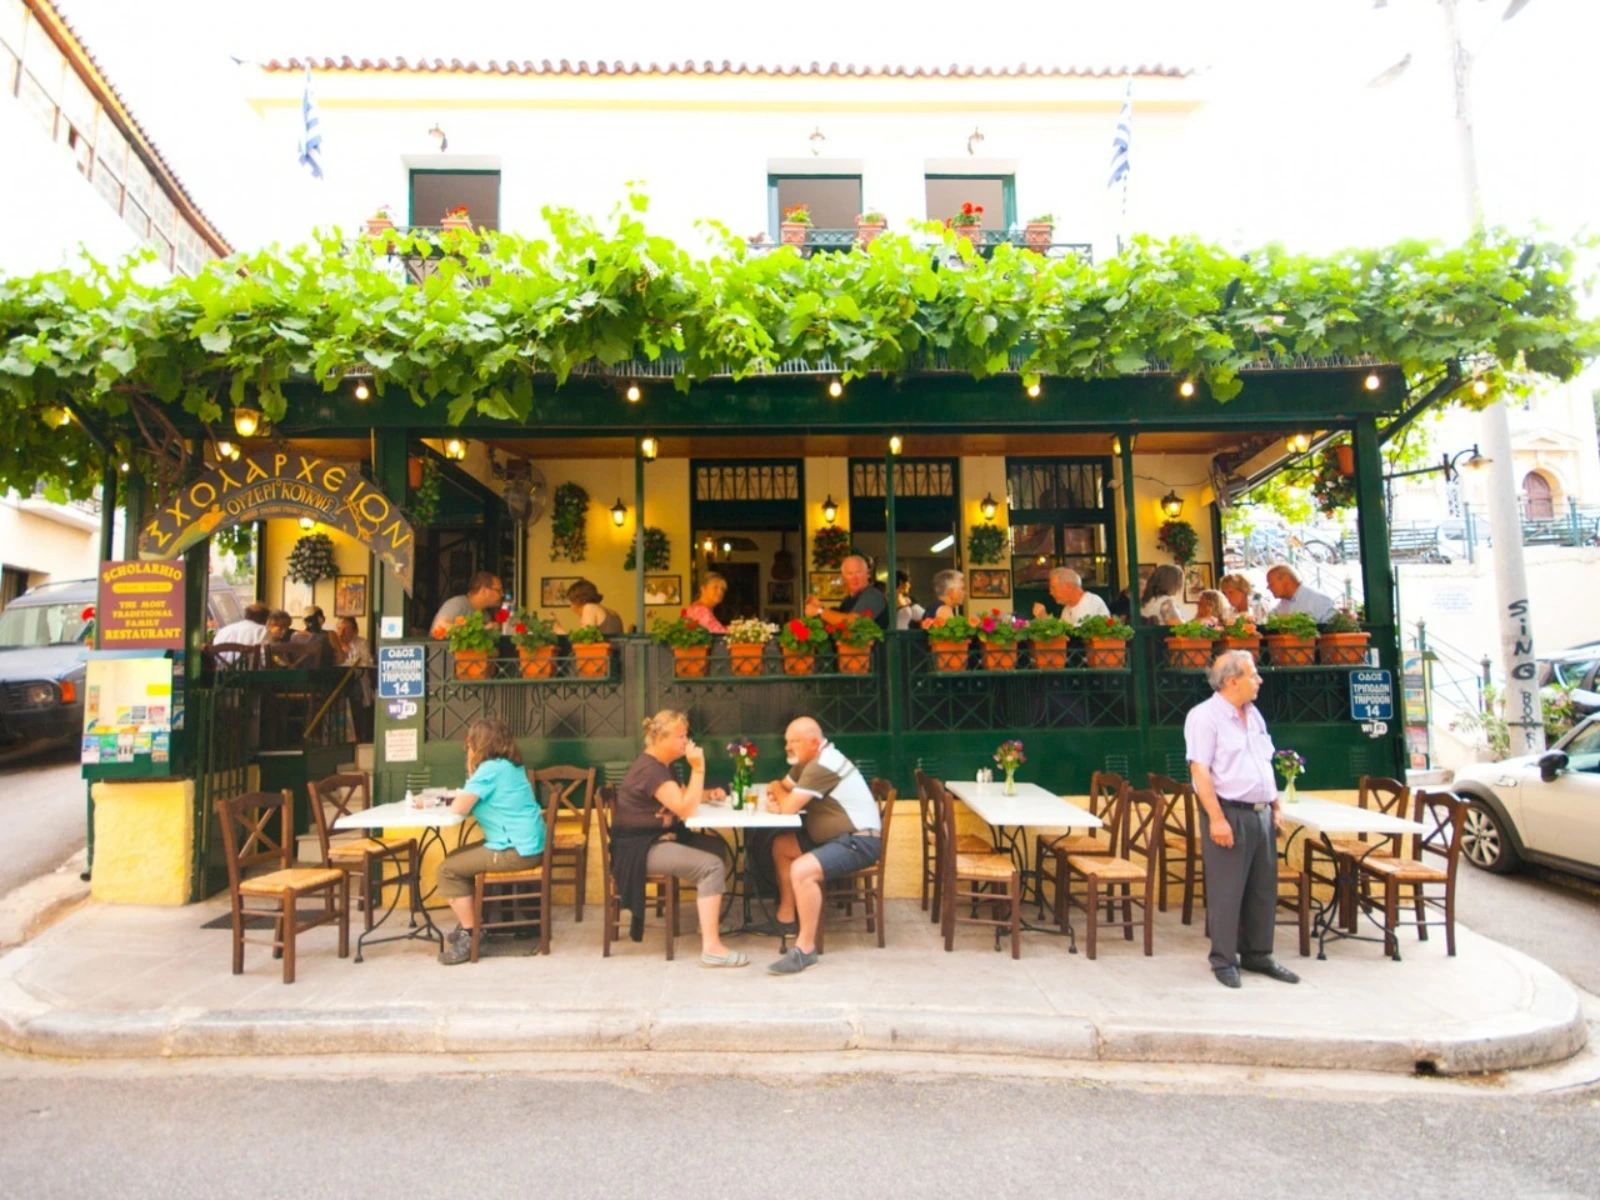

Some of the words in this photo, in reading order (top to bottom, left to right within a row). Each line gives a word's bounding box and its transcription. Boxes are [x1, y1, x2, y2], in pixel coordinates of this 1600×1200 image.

[102, 563, 182, 583] SCHOLARHIO
[119, 600, 137, 609] THE
[141, 600, 166, 609] MOST
[112, 609, 174, 619] TRADITIONAL
[125, 618, 160, 627] FAMILY
[104, 628, 181, 640] RESTAURANT
[393, 683, 410, 695] 14
[1364, 704, 1380, 717] 14
